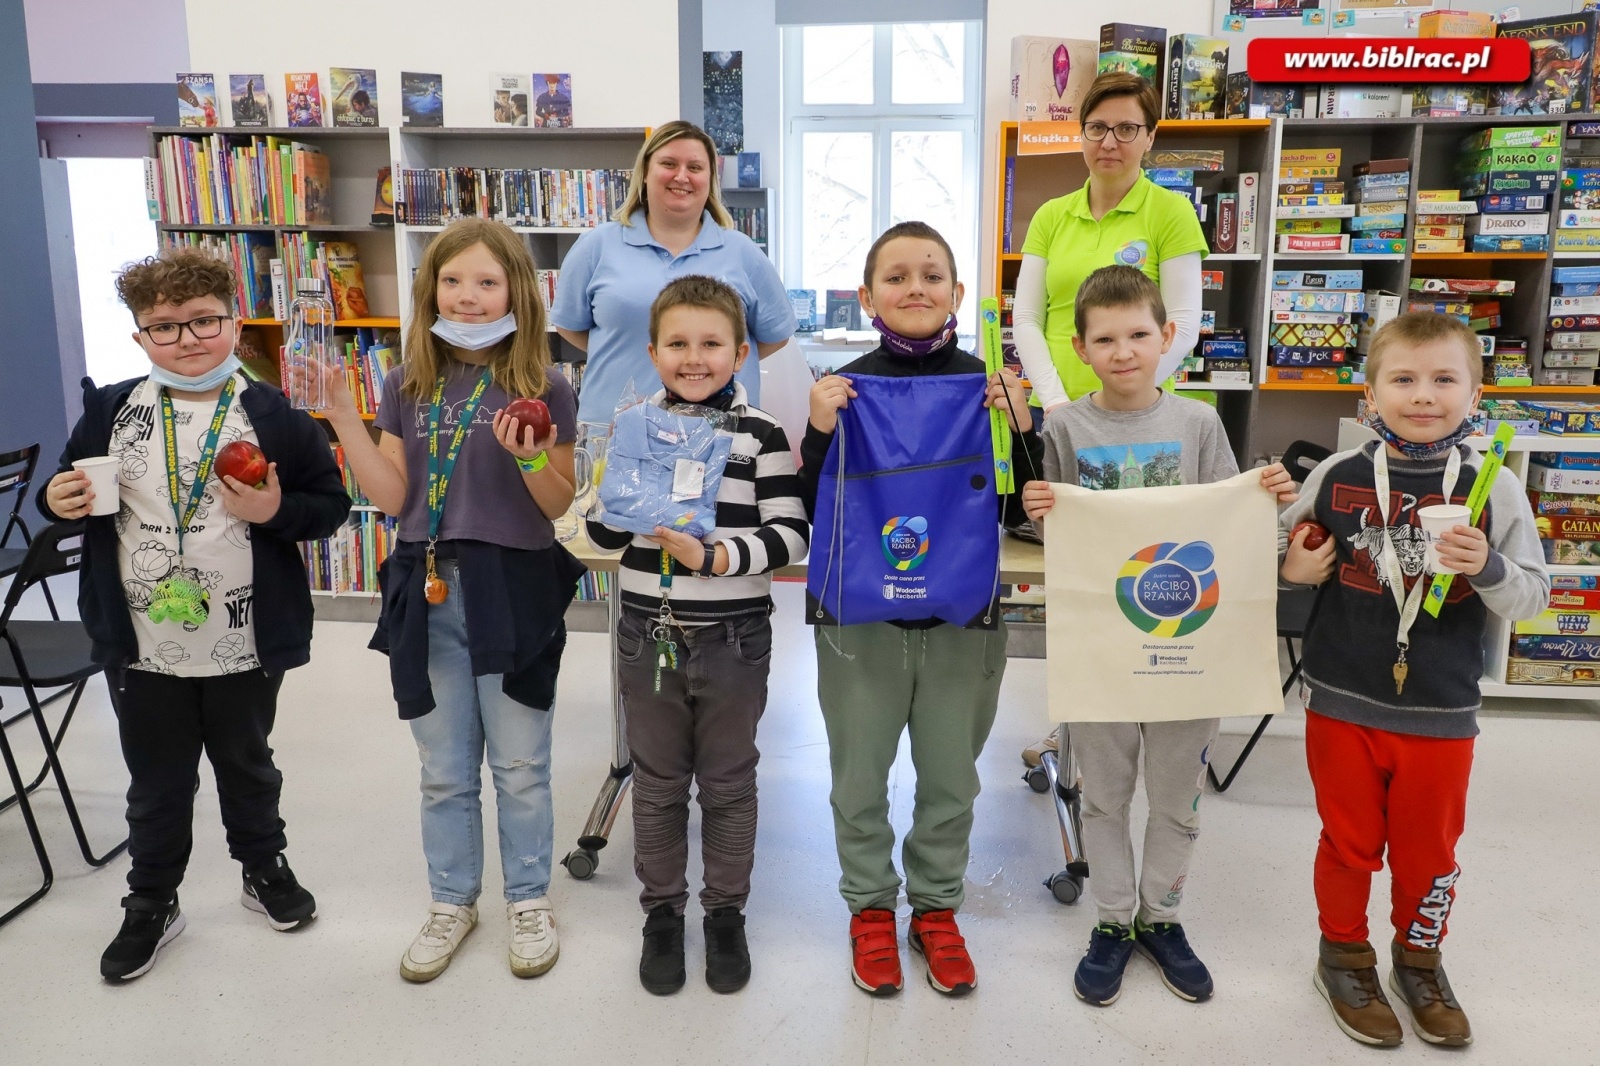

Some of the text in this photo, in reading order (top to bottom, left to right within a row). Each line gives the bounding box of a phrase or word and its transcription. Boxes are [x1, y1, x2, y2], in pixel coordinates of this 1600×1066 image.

[1553, 21, 1586, 37] END
[1187, 57, 1226, 70] CENTURY
[185, 76, 213, 84] SZANSA
[1172, 58, 1181, 103] CENTURY
[1022, 134, 1069, 145] Książka
[1496, 154, 1537, 165] KAKAO
[1220, 207, 1230, 242] CENTURY
[1485, 218, 1526, 230] DRAKO
[1210, 342, 1236, 350] Voodoo
[163, 406, 172, 416] NR
[164, 418, 177, 472] PODSTAWOWA
[170, 473, 178, 504] SZKOŁA
[165, 526, 171, 534] 2
[1562, 519, 1600, 532] CATAN
[225, 583, 253, 598] NOTHI
[895, 586, 927, 594] Wodociągi
[1143, 580, 1190, 591] RACIBO
[237, 591, 249, 599] BUT
[1144, 591, 1192, 601] RZANKA
[1552, 595, 1582, 604] Quoridor
[224, 595, 253, 629] NET
[1558, 615, 1590, 623] RYZYK
[1559, 622, 1587, 630] FIZYK
